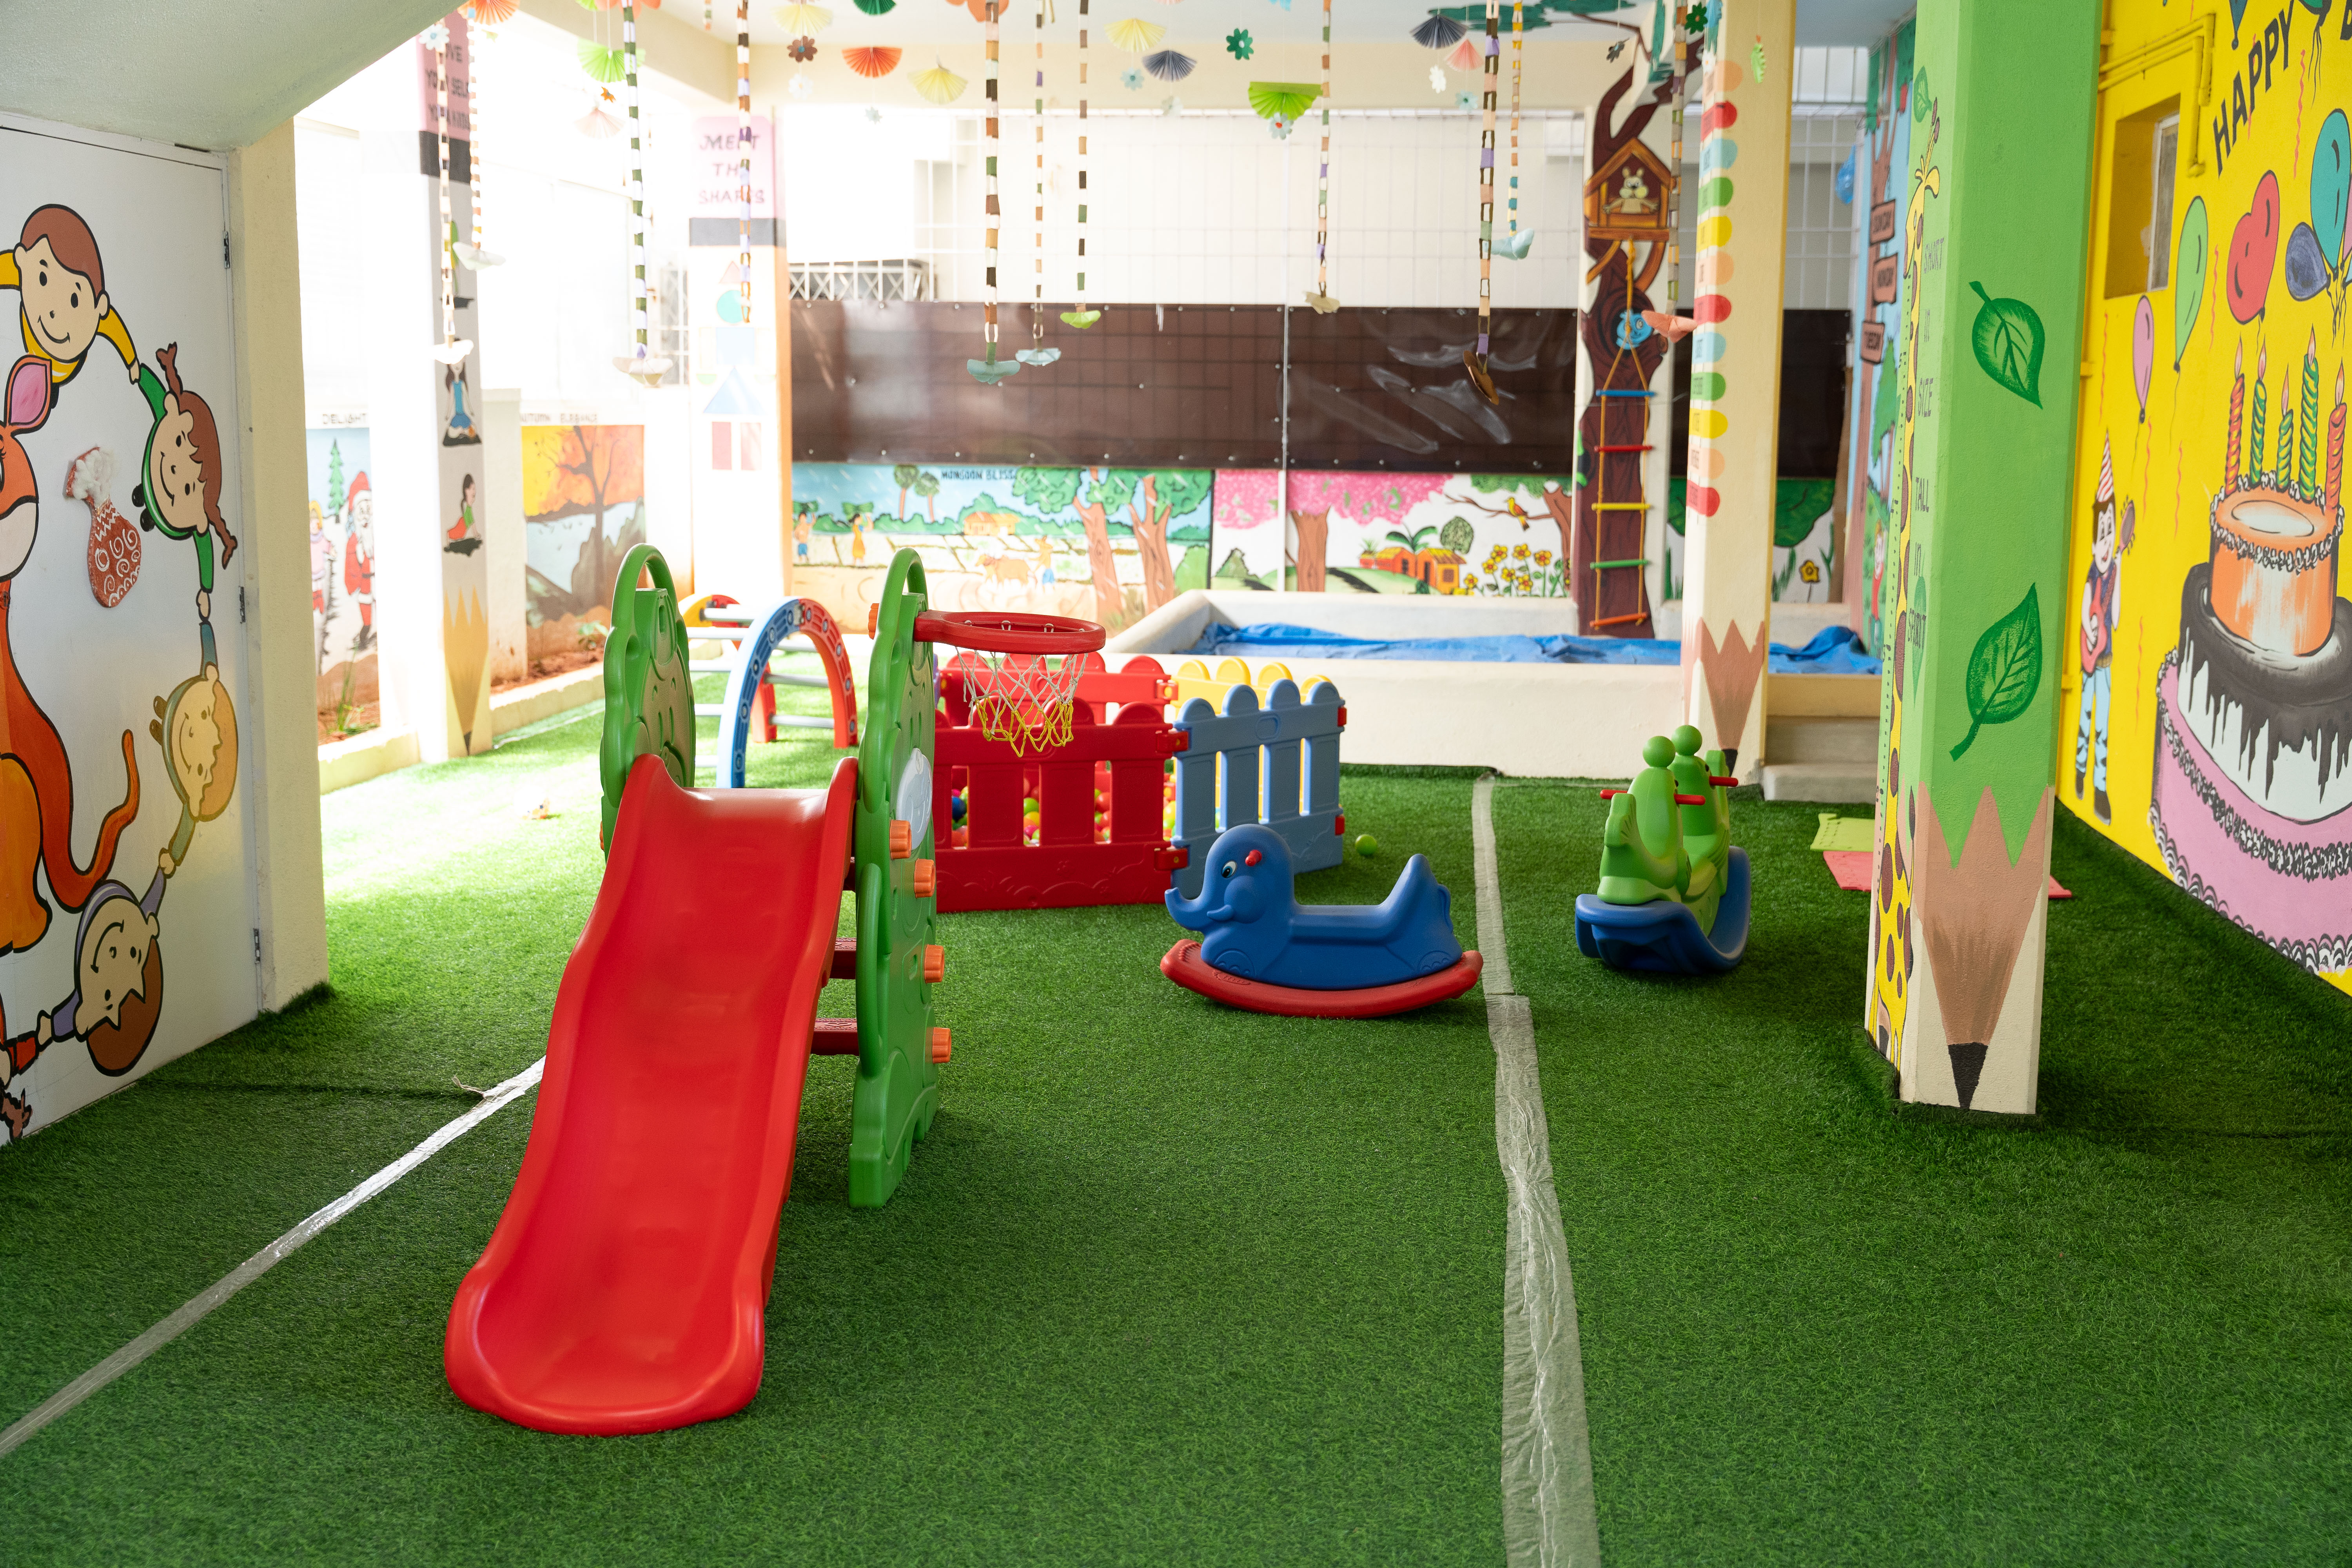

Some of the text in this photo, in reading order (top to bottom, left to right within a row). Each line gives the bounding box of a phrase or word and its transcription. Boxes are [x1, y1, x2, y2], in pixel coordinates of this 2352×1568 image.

[2213, 0, 2294, 179] HAPPY
[713, 162, 739, 176] TH
[1923, 237, 1945, 274] SHORT
[1918, 377, 1934, 418] SIZE
[941, 469, 982, 480] MONSOON
[1915, 476, 1929, 513] TALL
[1907, 607, 1927, 650] SPIRIT
